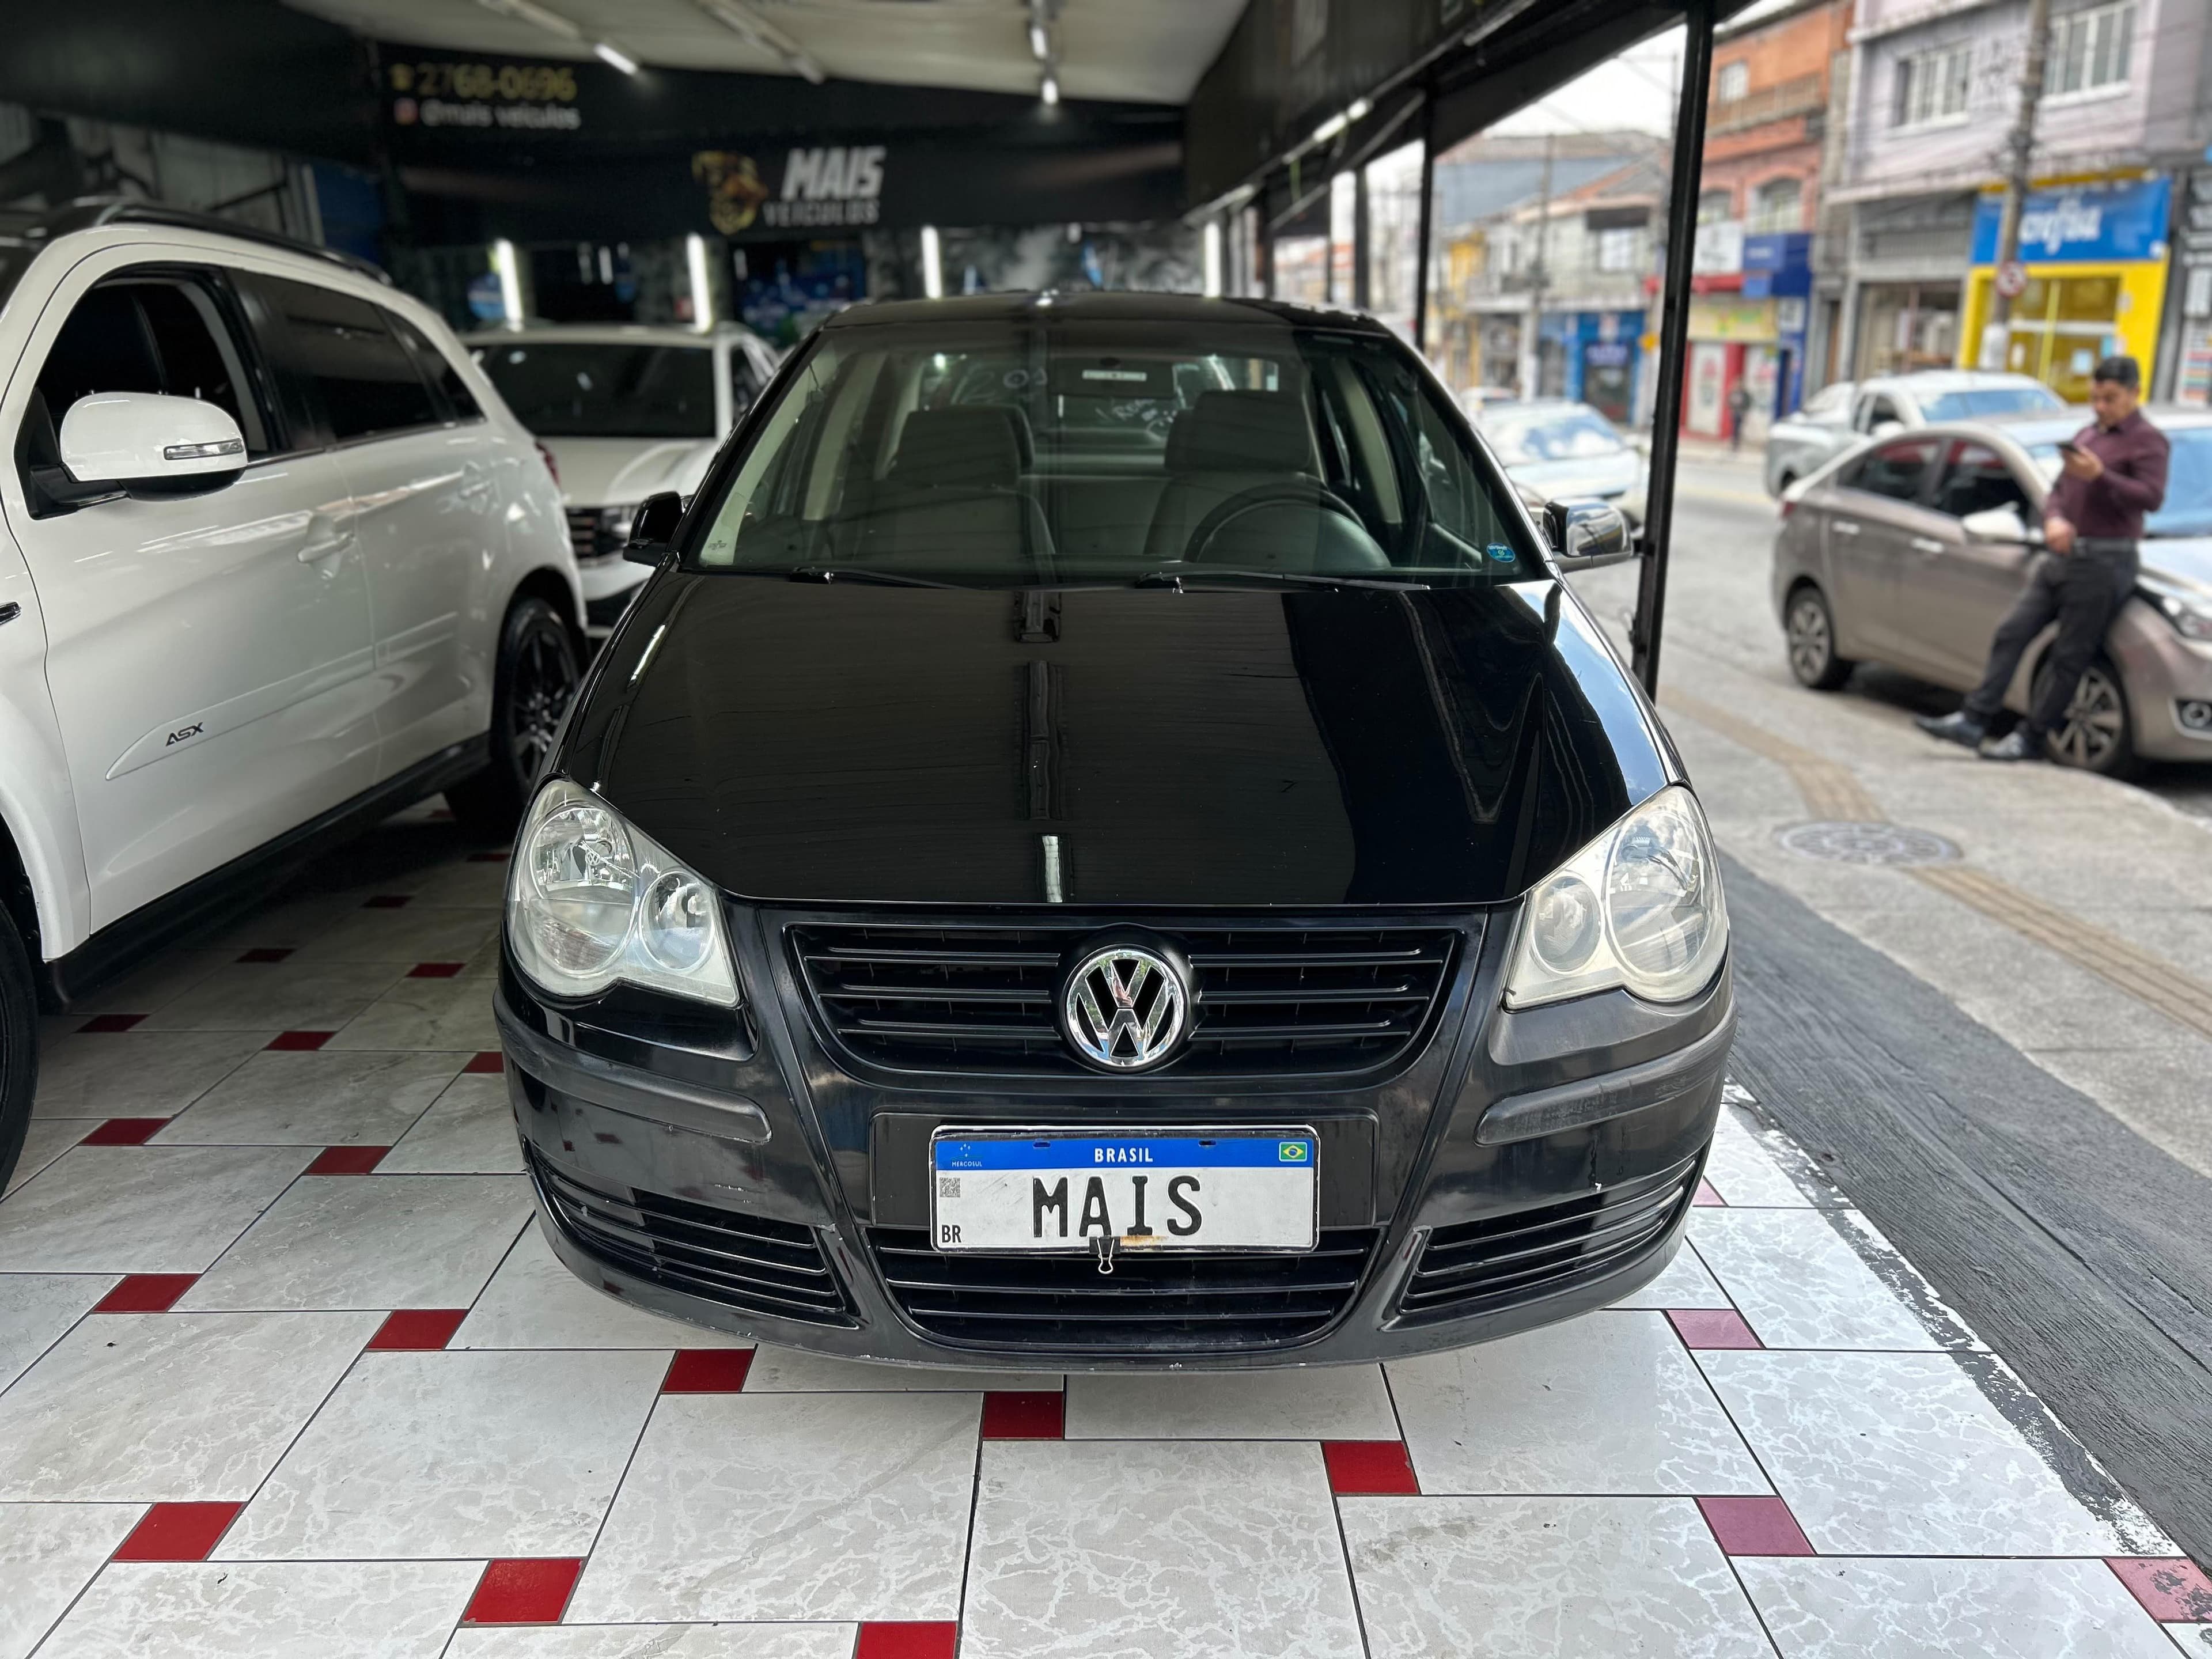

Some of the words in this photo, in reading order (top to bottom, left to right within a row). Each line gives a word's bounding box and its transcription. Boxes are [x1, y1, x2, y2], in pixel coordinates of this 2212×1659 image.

[780, 145, 887, 200] MAIS
[165, 721, 204, 747] ASX
[1067, 950, 1183, 1066] VW
[1094, 1147, 1153, 1163] BRASIL
[1032, 1175, 1203, 1238] MAIS
[941, 1224, 962, 1244] BR
